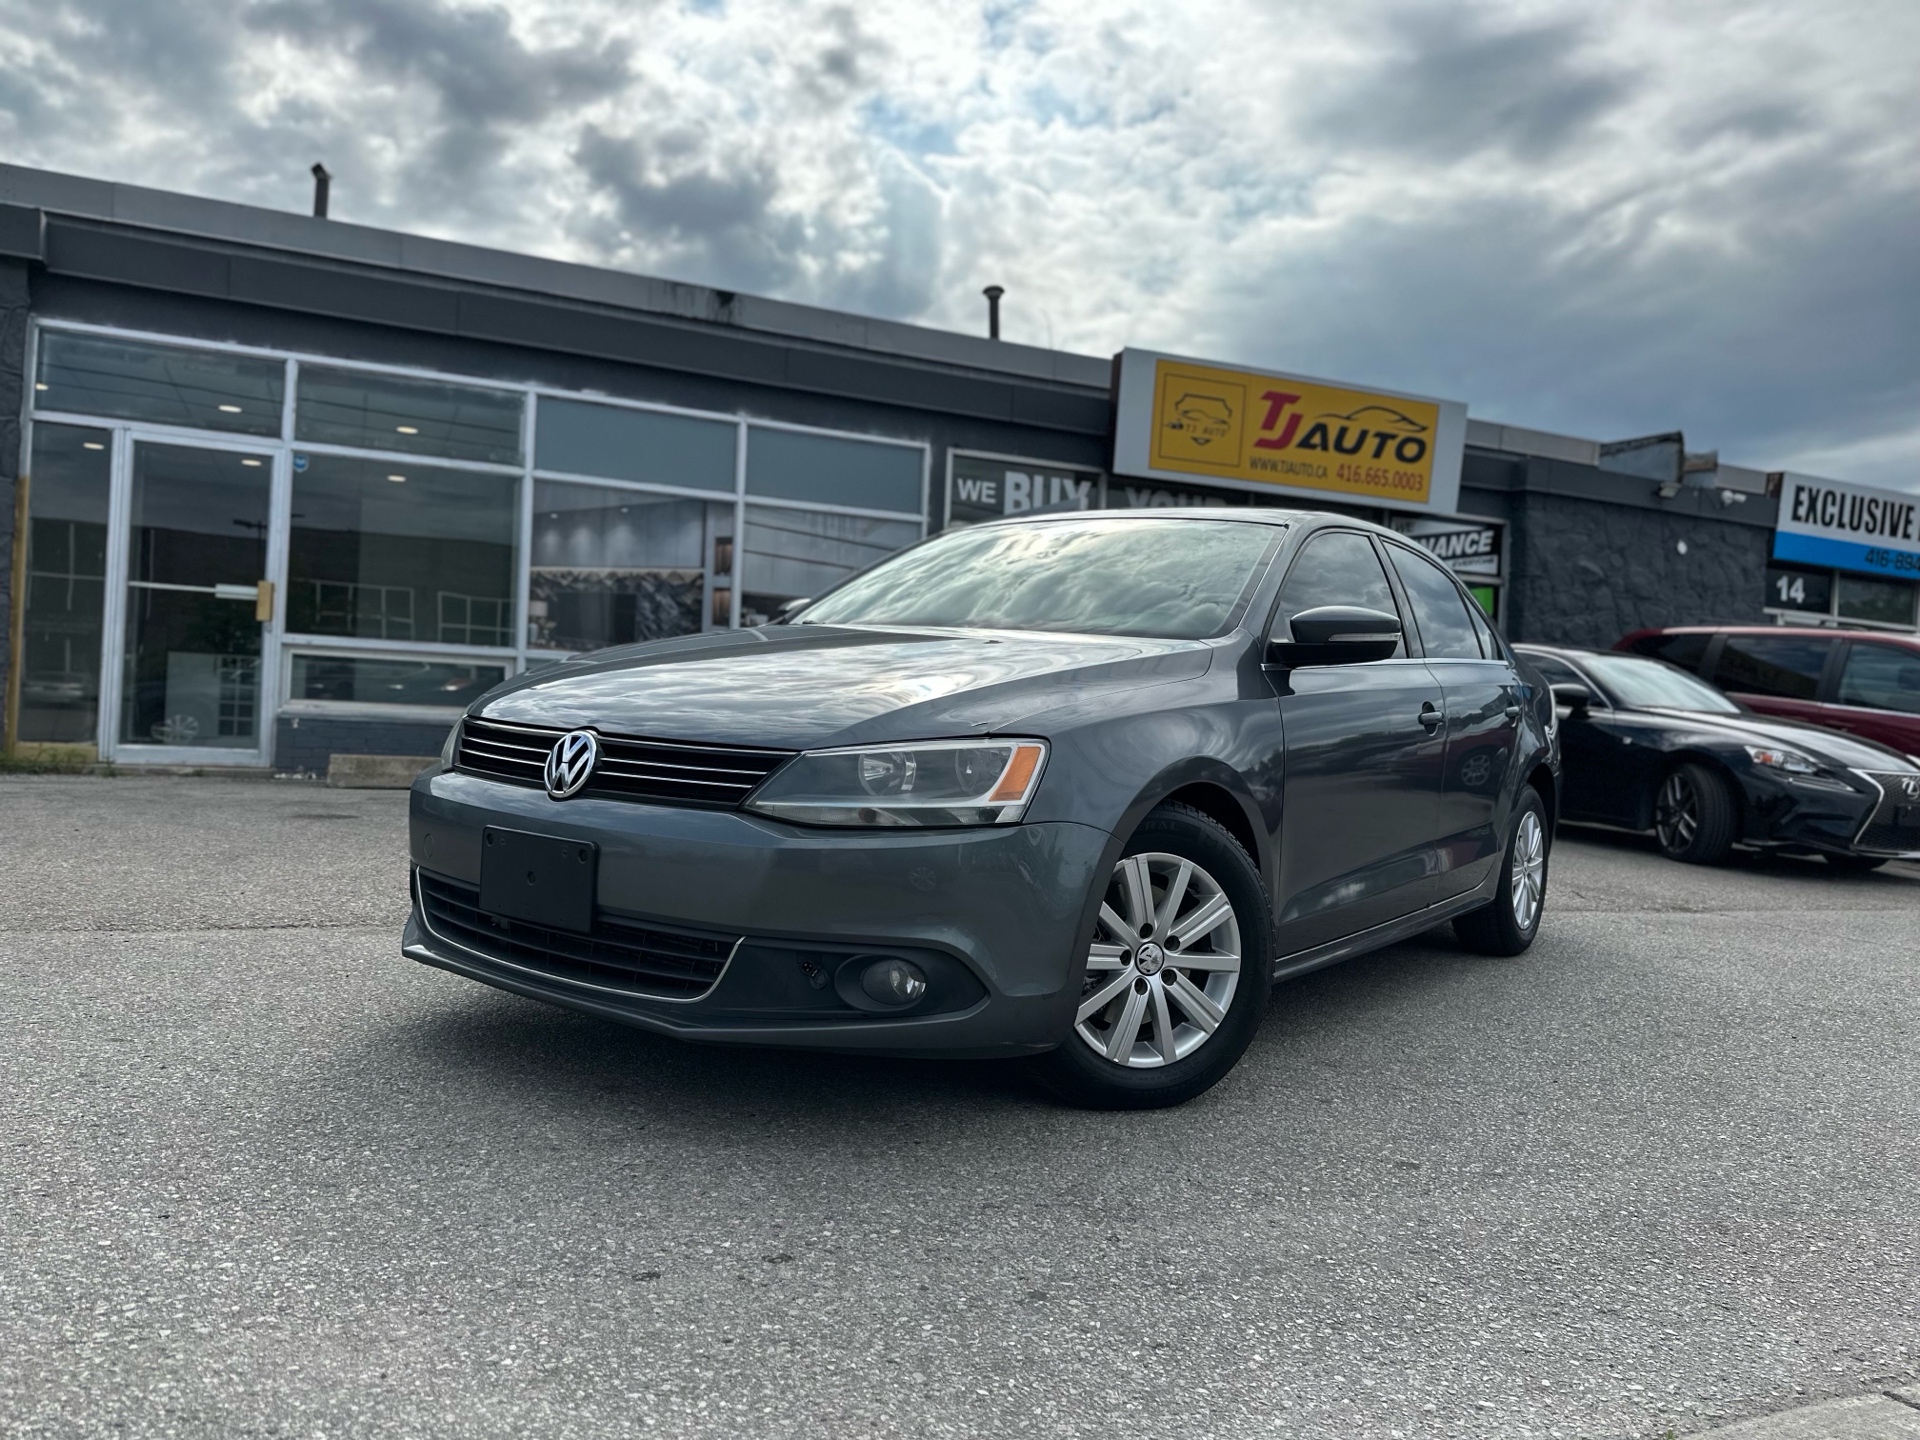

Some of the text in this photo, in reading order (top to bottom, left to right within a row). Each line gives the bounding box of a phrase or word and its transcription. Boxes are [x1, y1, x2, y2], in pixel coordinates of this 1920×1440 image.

[1249, 456, 1328, 479] WWW.TJAUTO.CA
[1336, 463, 1423, 492] 416.665.0003
[958, 478, 996, 504] WE
[1005, 471, 1091, 514] BUY
[1791, 485, 1915, 540] EXCLUSIVE
[1419, 530, 1494, 557] NANCE
[1776, 575, 1805, 604] 14
